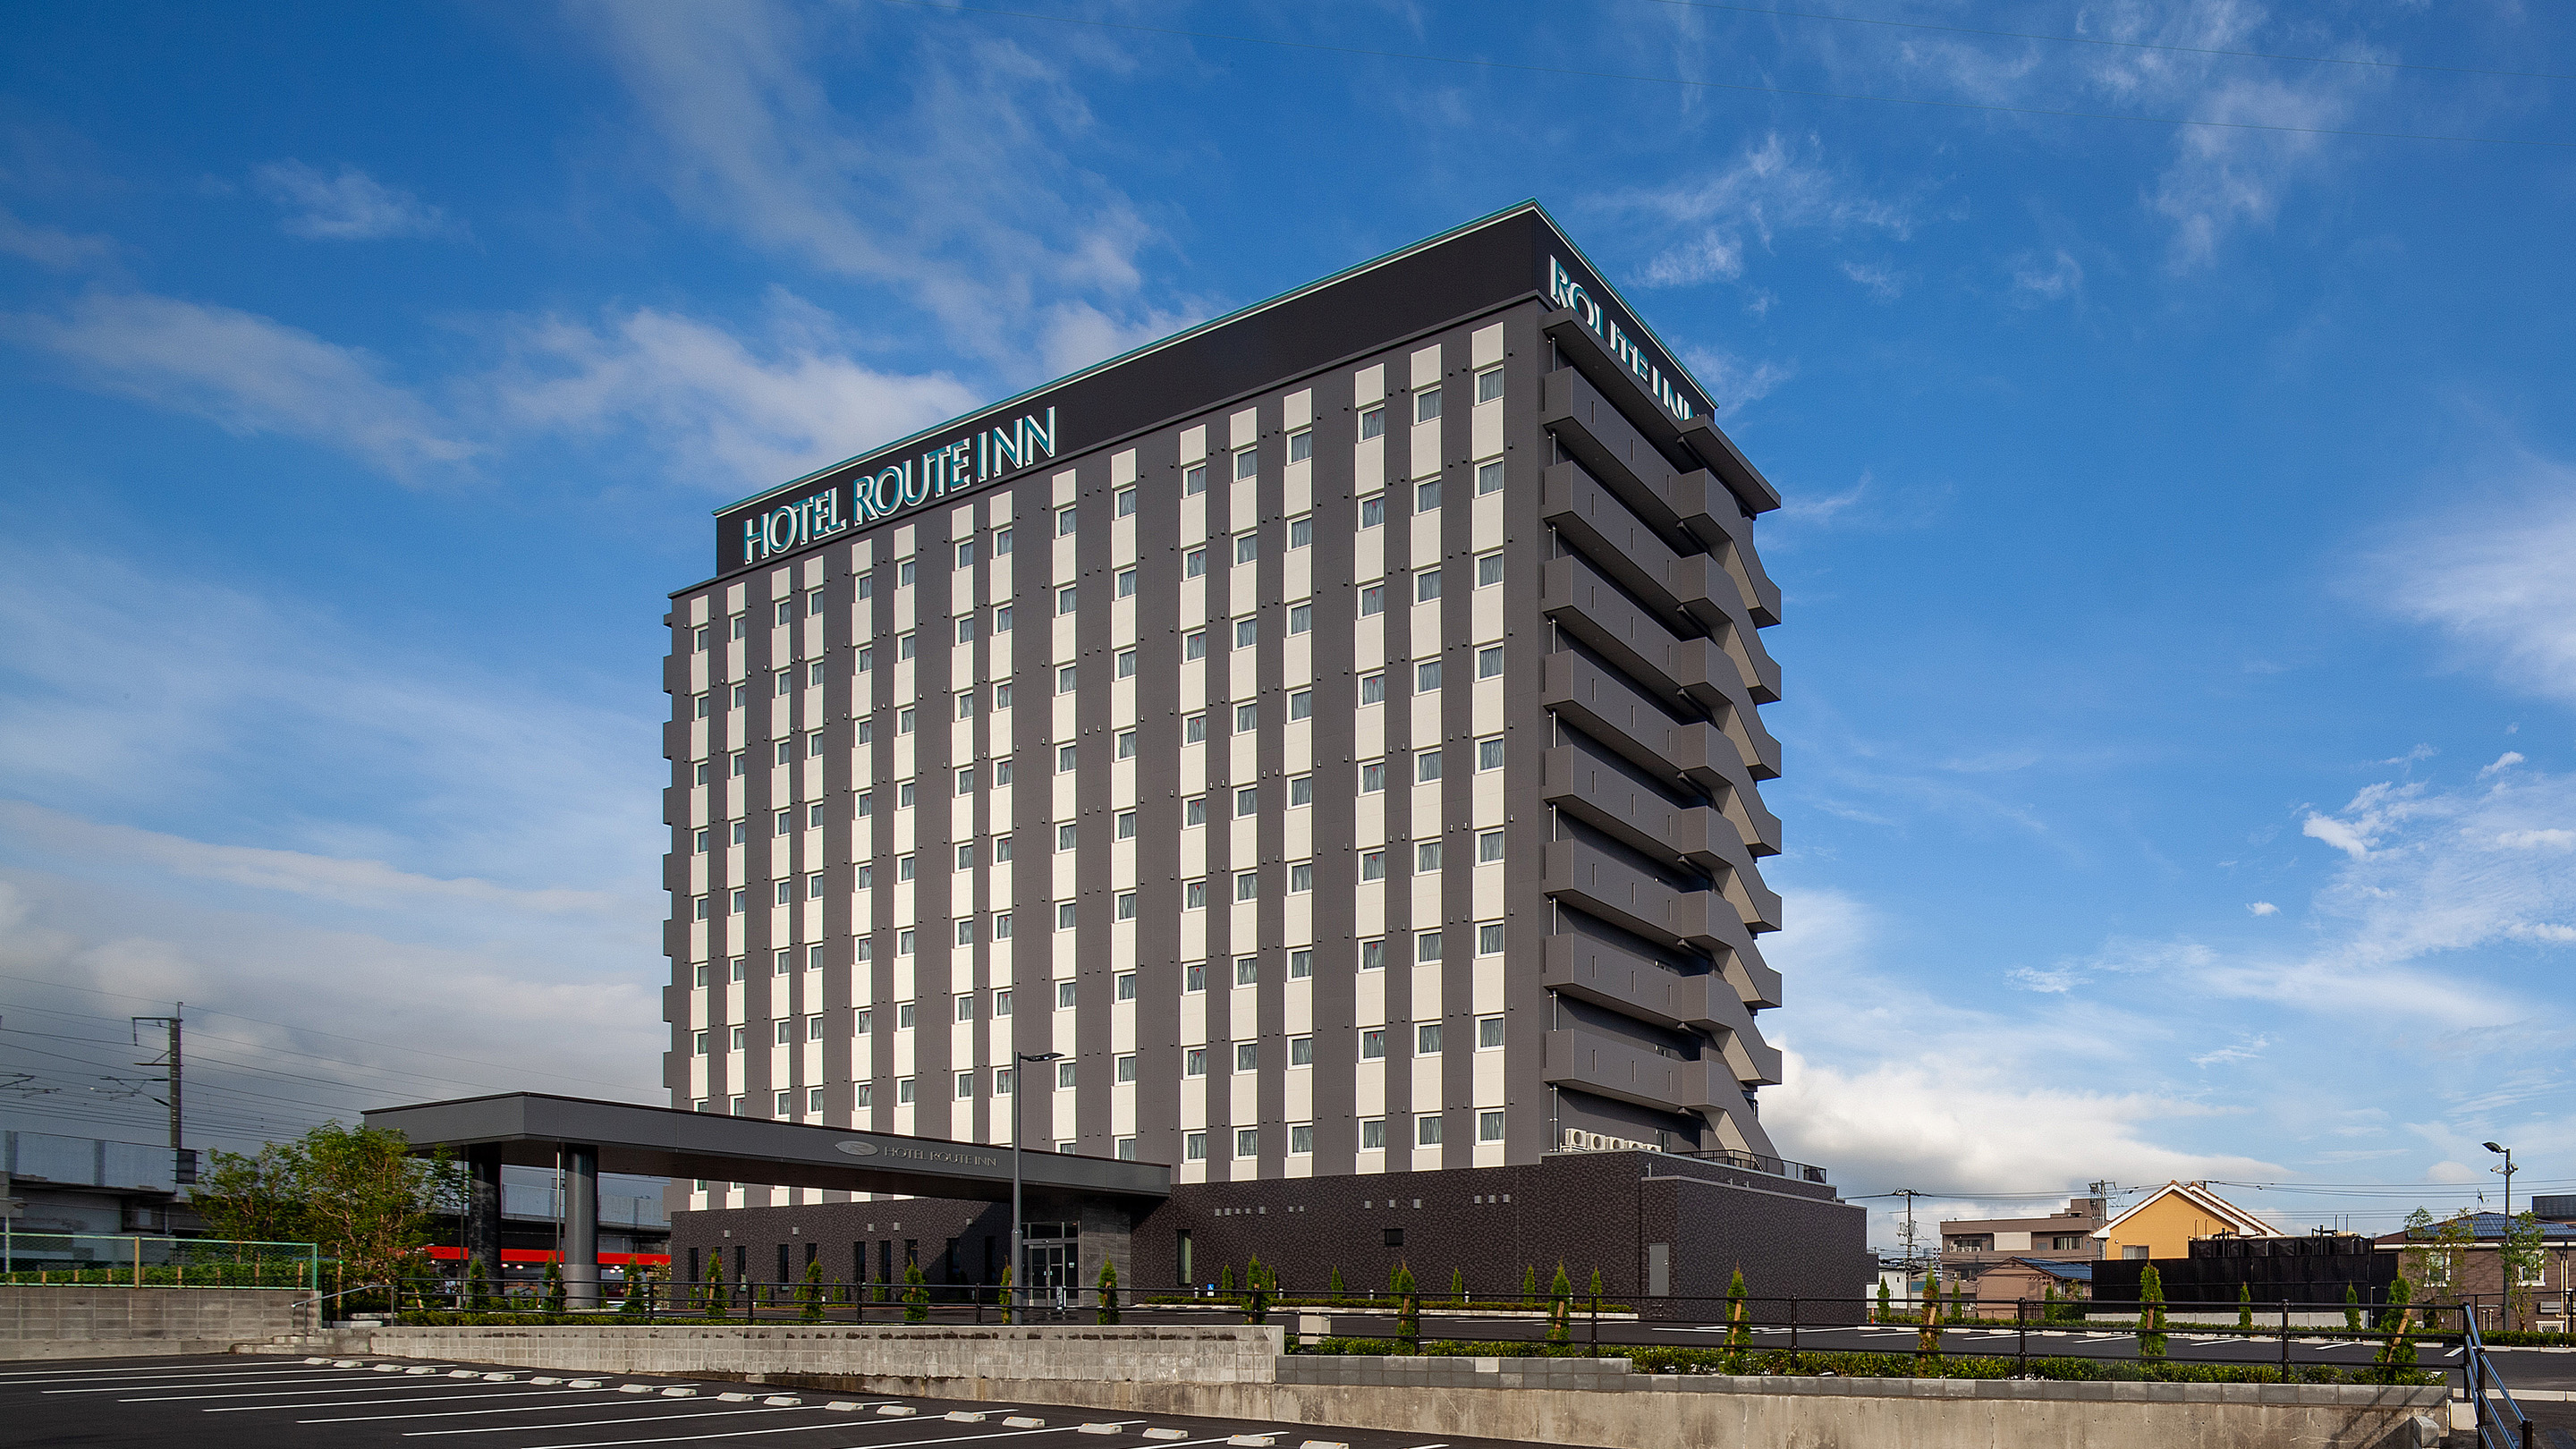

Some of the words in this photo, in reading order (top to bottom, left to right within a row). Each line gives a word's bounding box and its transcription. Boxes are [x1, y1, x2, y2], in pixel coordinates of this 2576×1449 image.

[743, 487, 847, 565] HOTEL
[853, 437, 970, 527] ROUTE
[977, 405, 1055, 483] INN
[884, 1146, 928, 1160] HOTEL
[930, 1150, 972, 1164] ROUTE
[974, 1156, 998, 1166] INN
